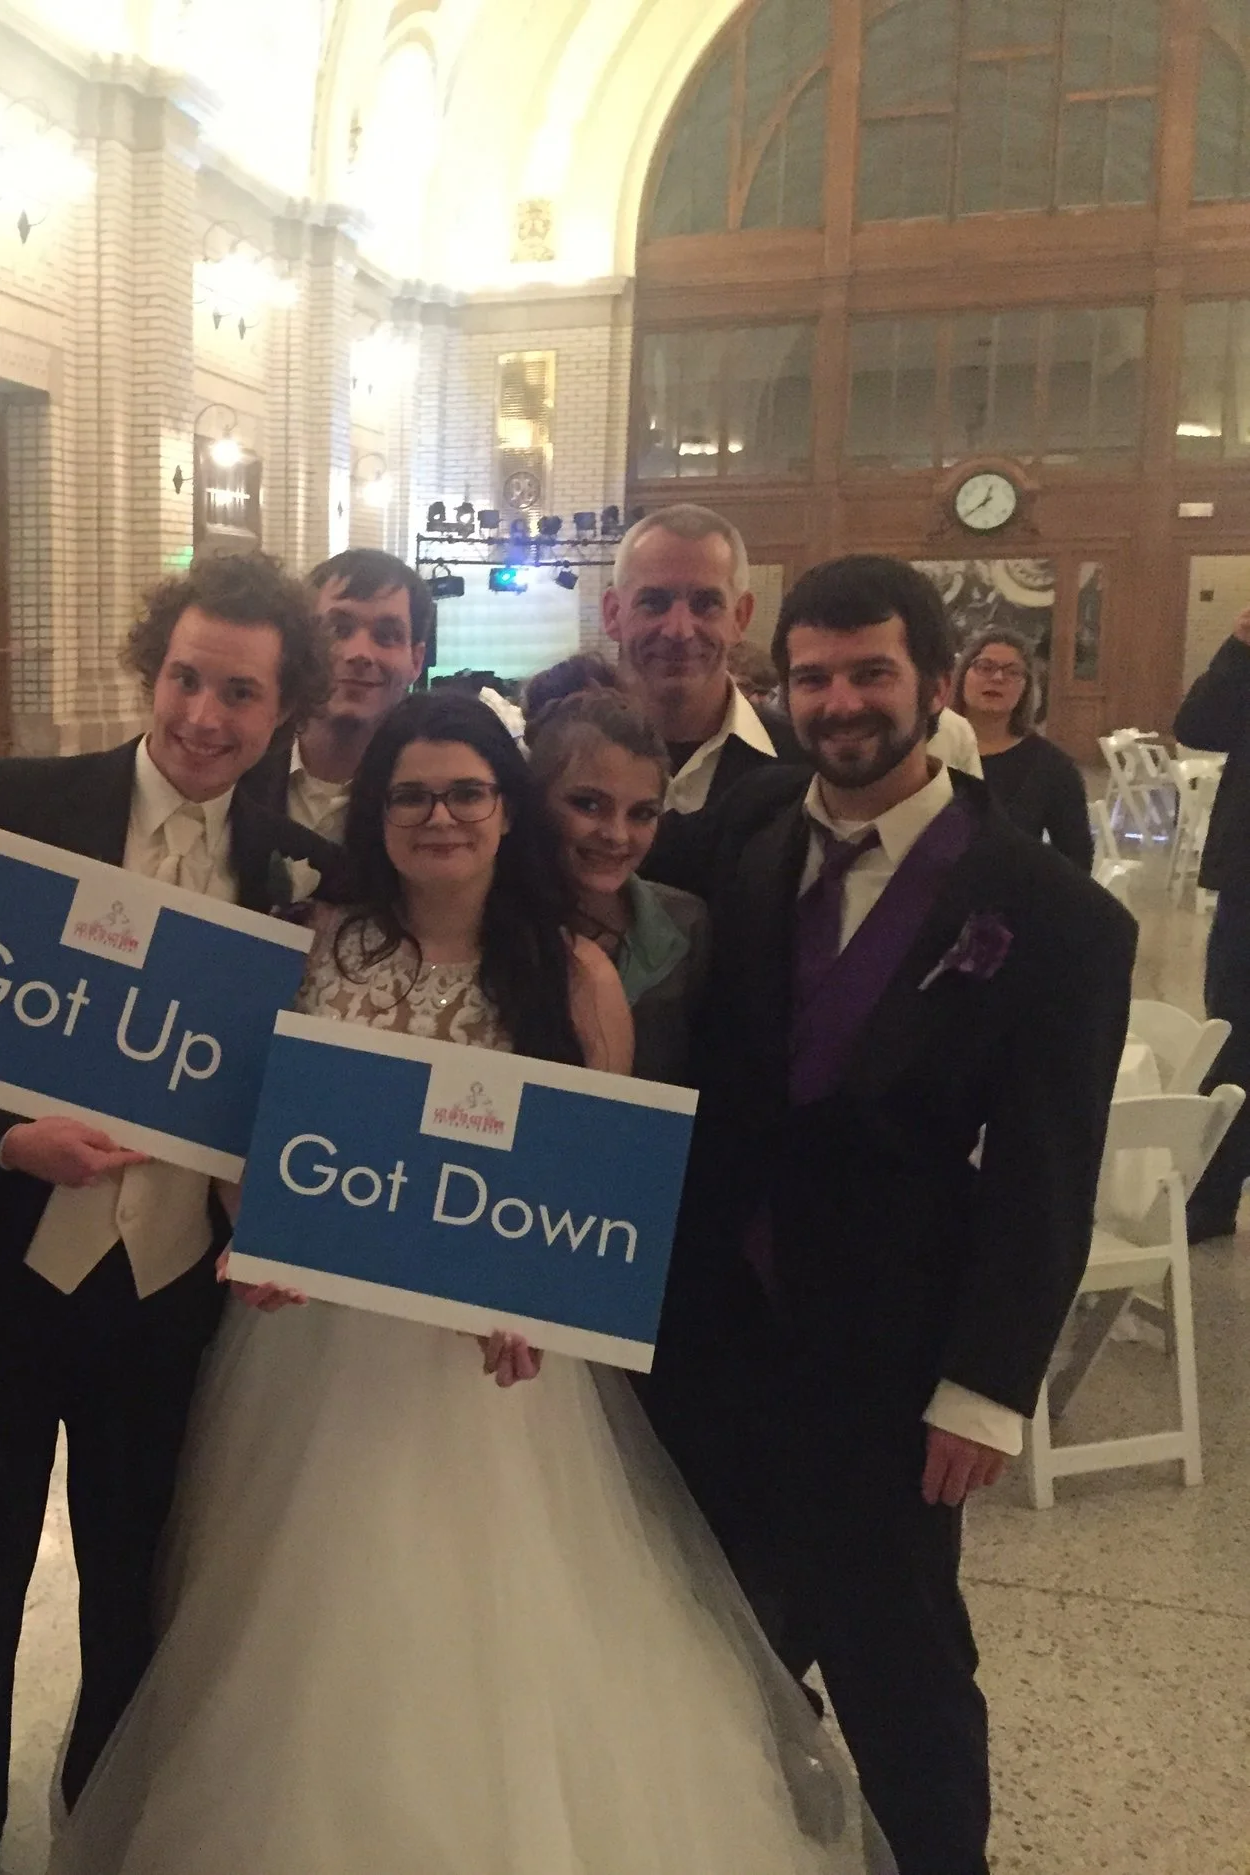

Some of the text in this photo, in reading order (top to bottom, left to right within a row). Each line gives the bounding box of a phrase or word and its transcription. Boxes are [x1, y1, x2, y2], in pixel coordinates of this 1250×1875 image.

[116, 986, 222, 1091] Up
[279, 1133, 638, 1263] Got Down
